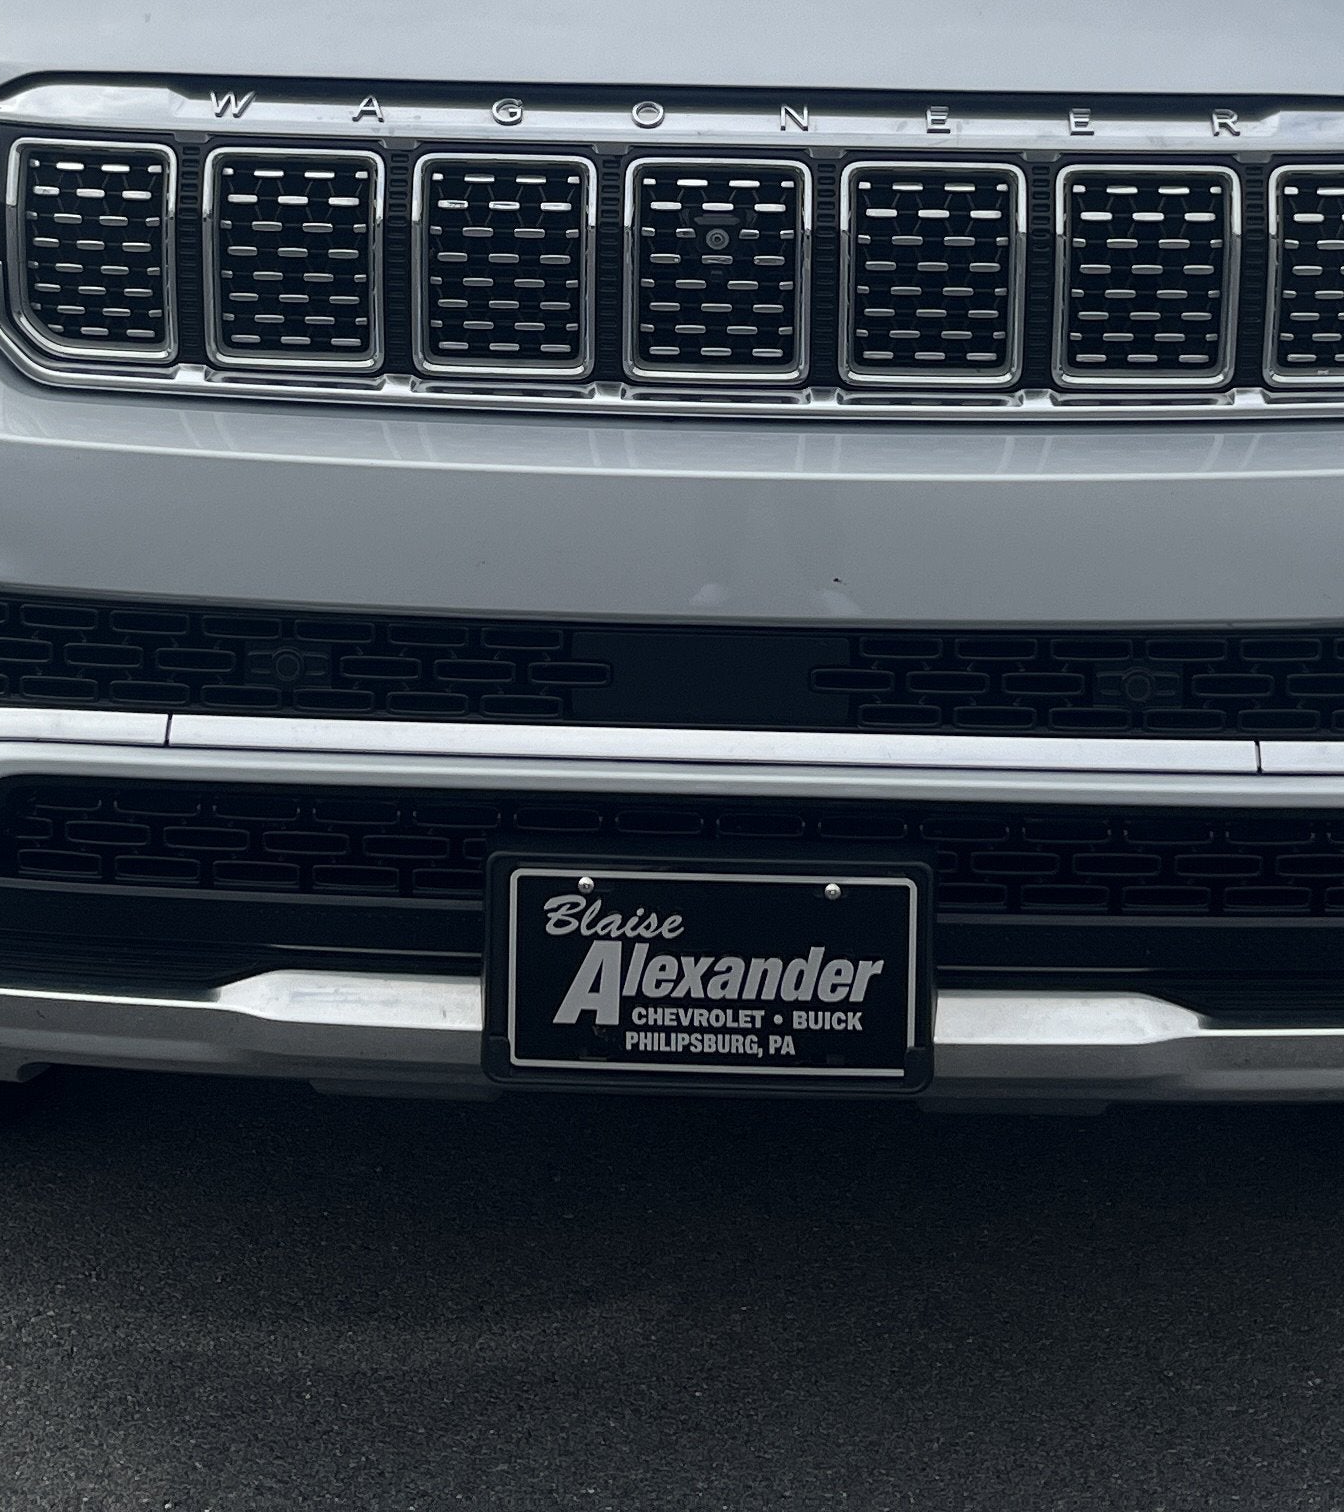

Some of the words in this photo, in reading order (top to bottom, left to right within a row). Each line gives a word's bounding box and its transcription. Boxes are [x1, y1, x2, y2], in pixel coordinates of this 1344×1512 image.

[209, 90, 1241, 137] WAGONEER
[544, 893, 684, 939] Blaise
[553, 939, 884, 1026] Alexander
[632, 1007, 765, 1029] CHEVROLET
[792, 1011, 862, 1031] BUICK
[625, 1033, 764, 1058] PHILIPSBURG,
[769, 1036, 796, 1056] PA
